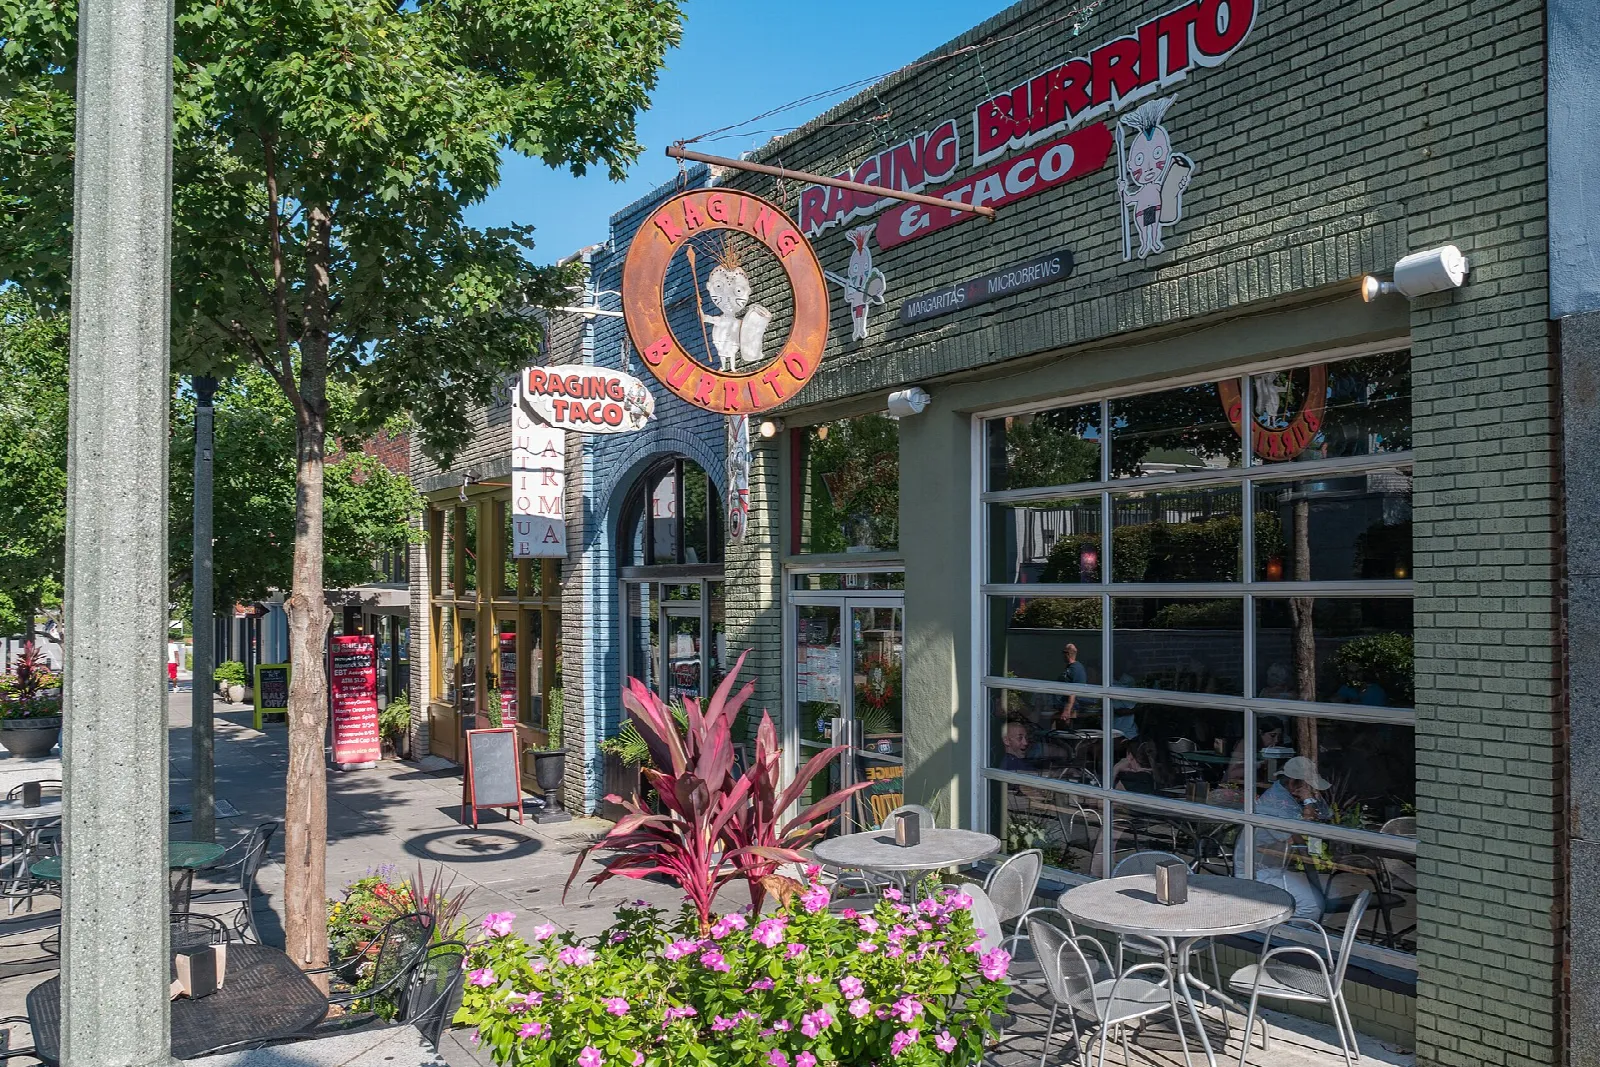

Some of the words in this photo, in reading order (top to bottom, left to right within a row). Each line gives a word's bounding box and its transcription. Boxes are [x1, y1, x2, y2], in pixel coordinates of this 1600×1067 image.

[801, 120, 958, 234] RAGING
[974, 0, 1257, 160] BURRITO
[900, 205, 930, 237] &
[942, 144, 1075, 218] TACO
[654, 194, 800, 259] RAGING
[907, 287, 965, 318] MARGARITAS
[987, 257, 1061, 294] MICROBREWS
[528, 369, 625, 402] RAGING
[644, 335, 810, 411] BURRITO
[552, 399, 624, 426] TACO
[538, 421, 562, 544] ARMA
